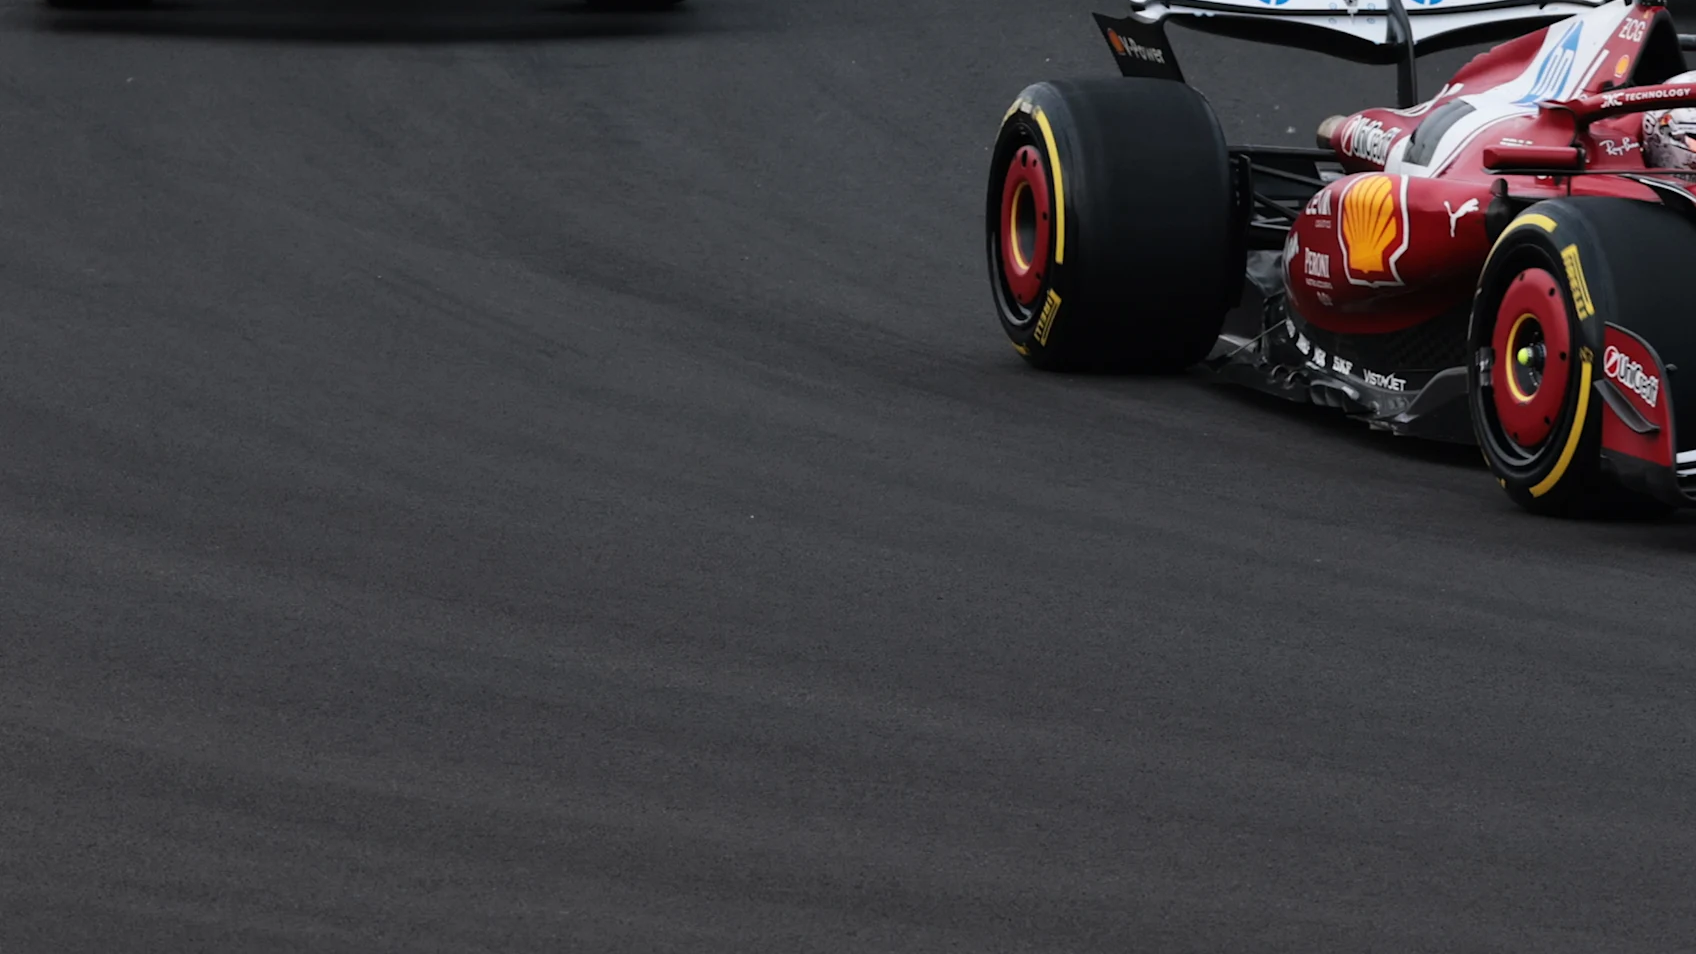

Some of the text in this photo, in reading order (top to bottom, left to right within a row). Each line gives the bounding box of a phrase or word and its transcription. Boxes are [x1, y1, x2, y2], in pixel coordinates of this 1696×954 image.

[1119, 35, 1166, 65] V-Power
[1625, 88, 1691, 102] TECHNOLOGY
[1304, 247, 1330, 279] PERONI
[1332, 355, 1354, 376] SKF
[1619, 352, 1659, 408] UniCredit
